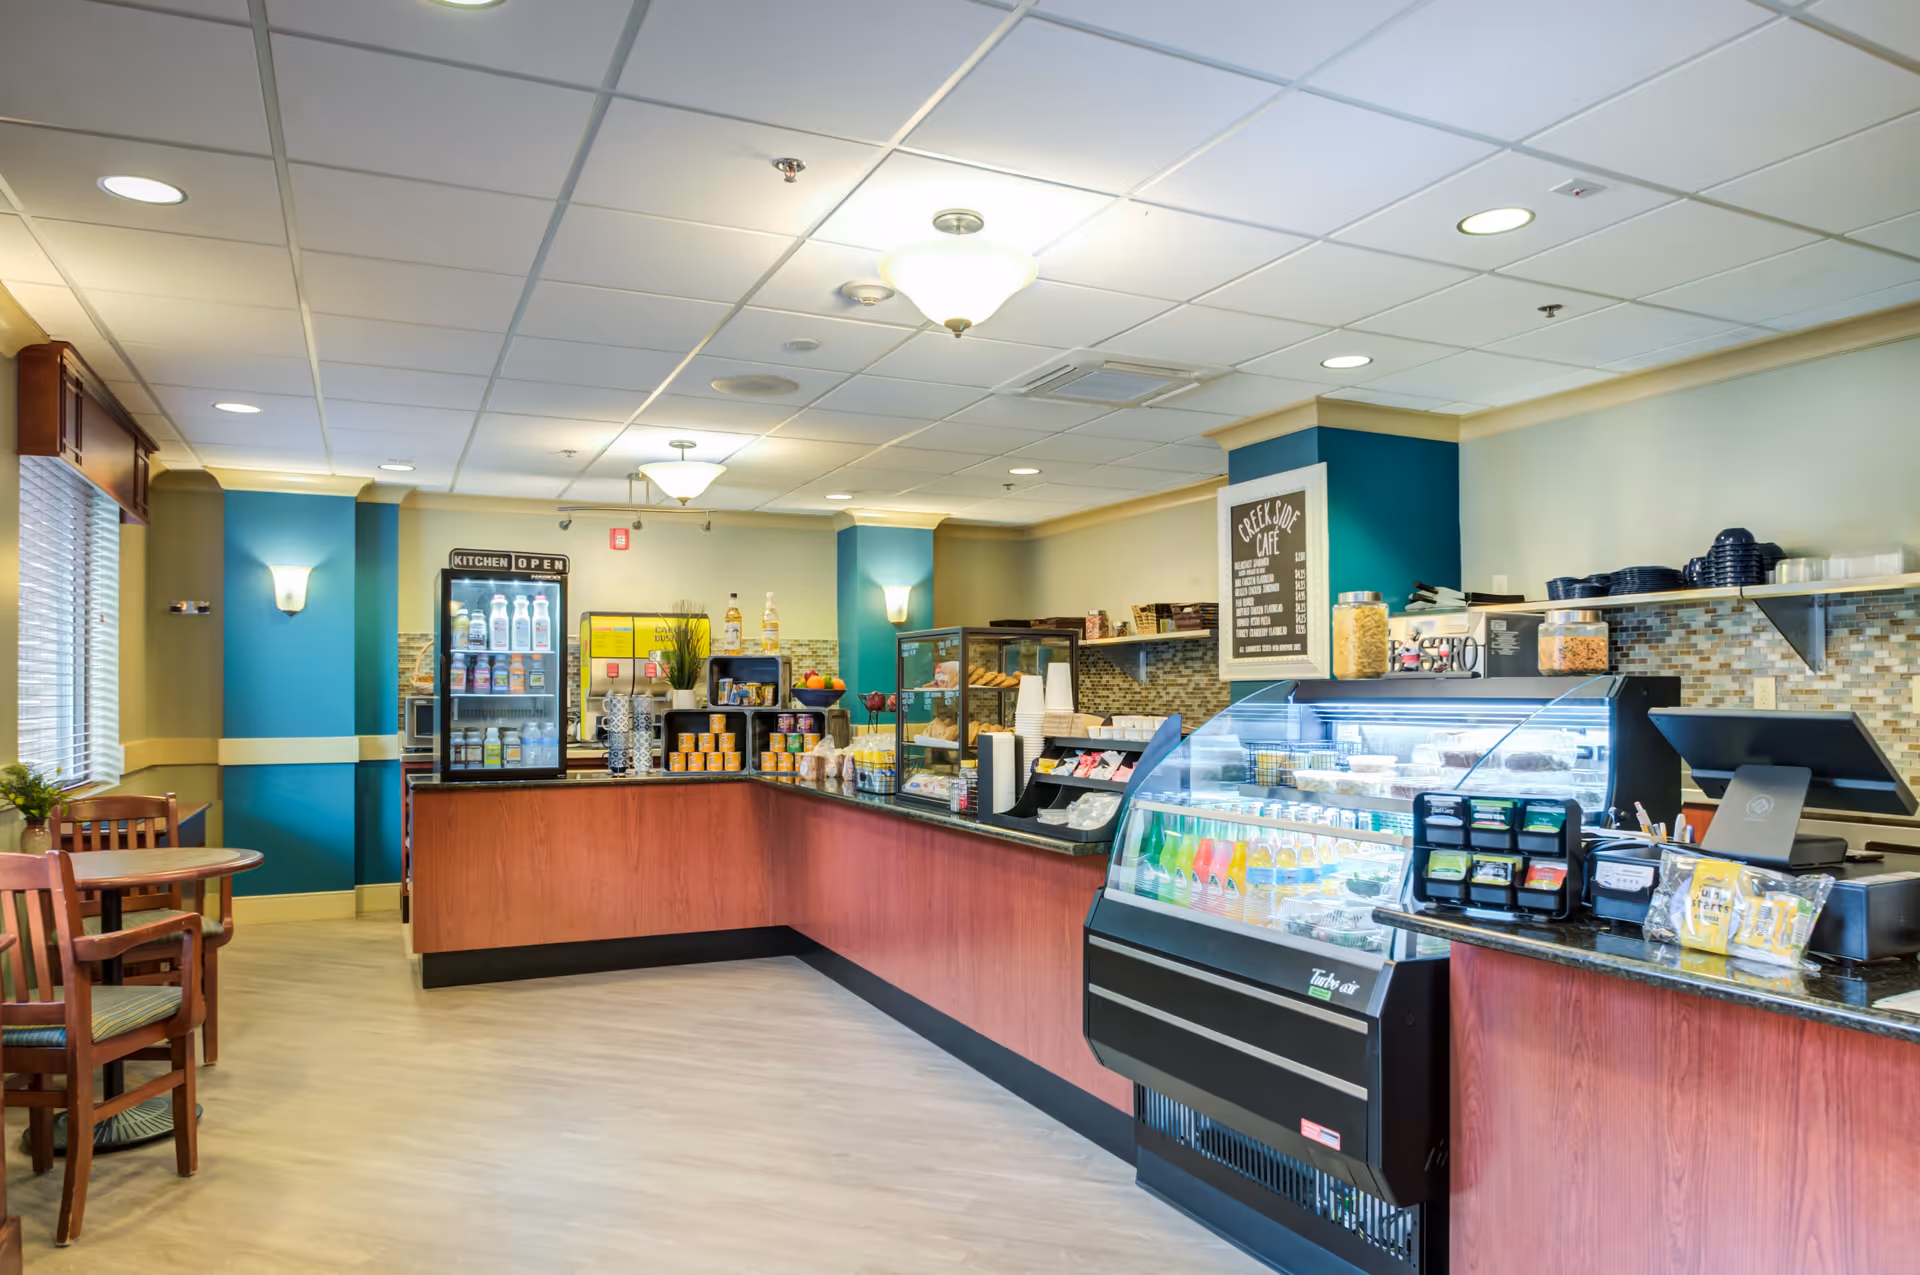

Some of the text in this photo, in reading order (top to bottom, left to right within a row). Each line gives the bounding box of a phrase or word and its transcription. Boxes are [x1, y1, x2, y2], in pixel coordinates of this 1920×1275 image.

[1238, 500, 1300, 543] CREEK SIDE
[454, 555, 563, 570] KITCHEN OPEN
[1390, 636, 1478, 672] BSTRO
[1310, 968, 1340, 990] Turbo
[1339, 980, 1360, 996] air
